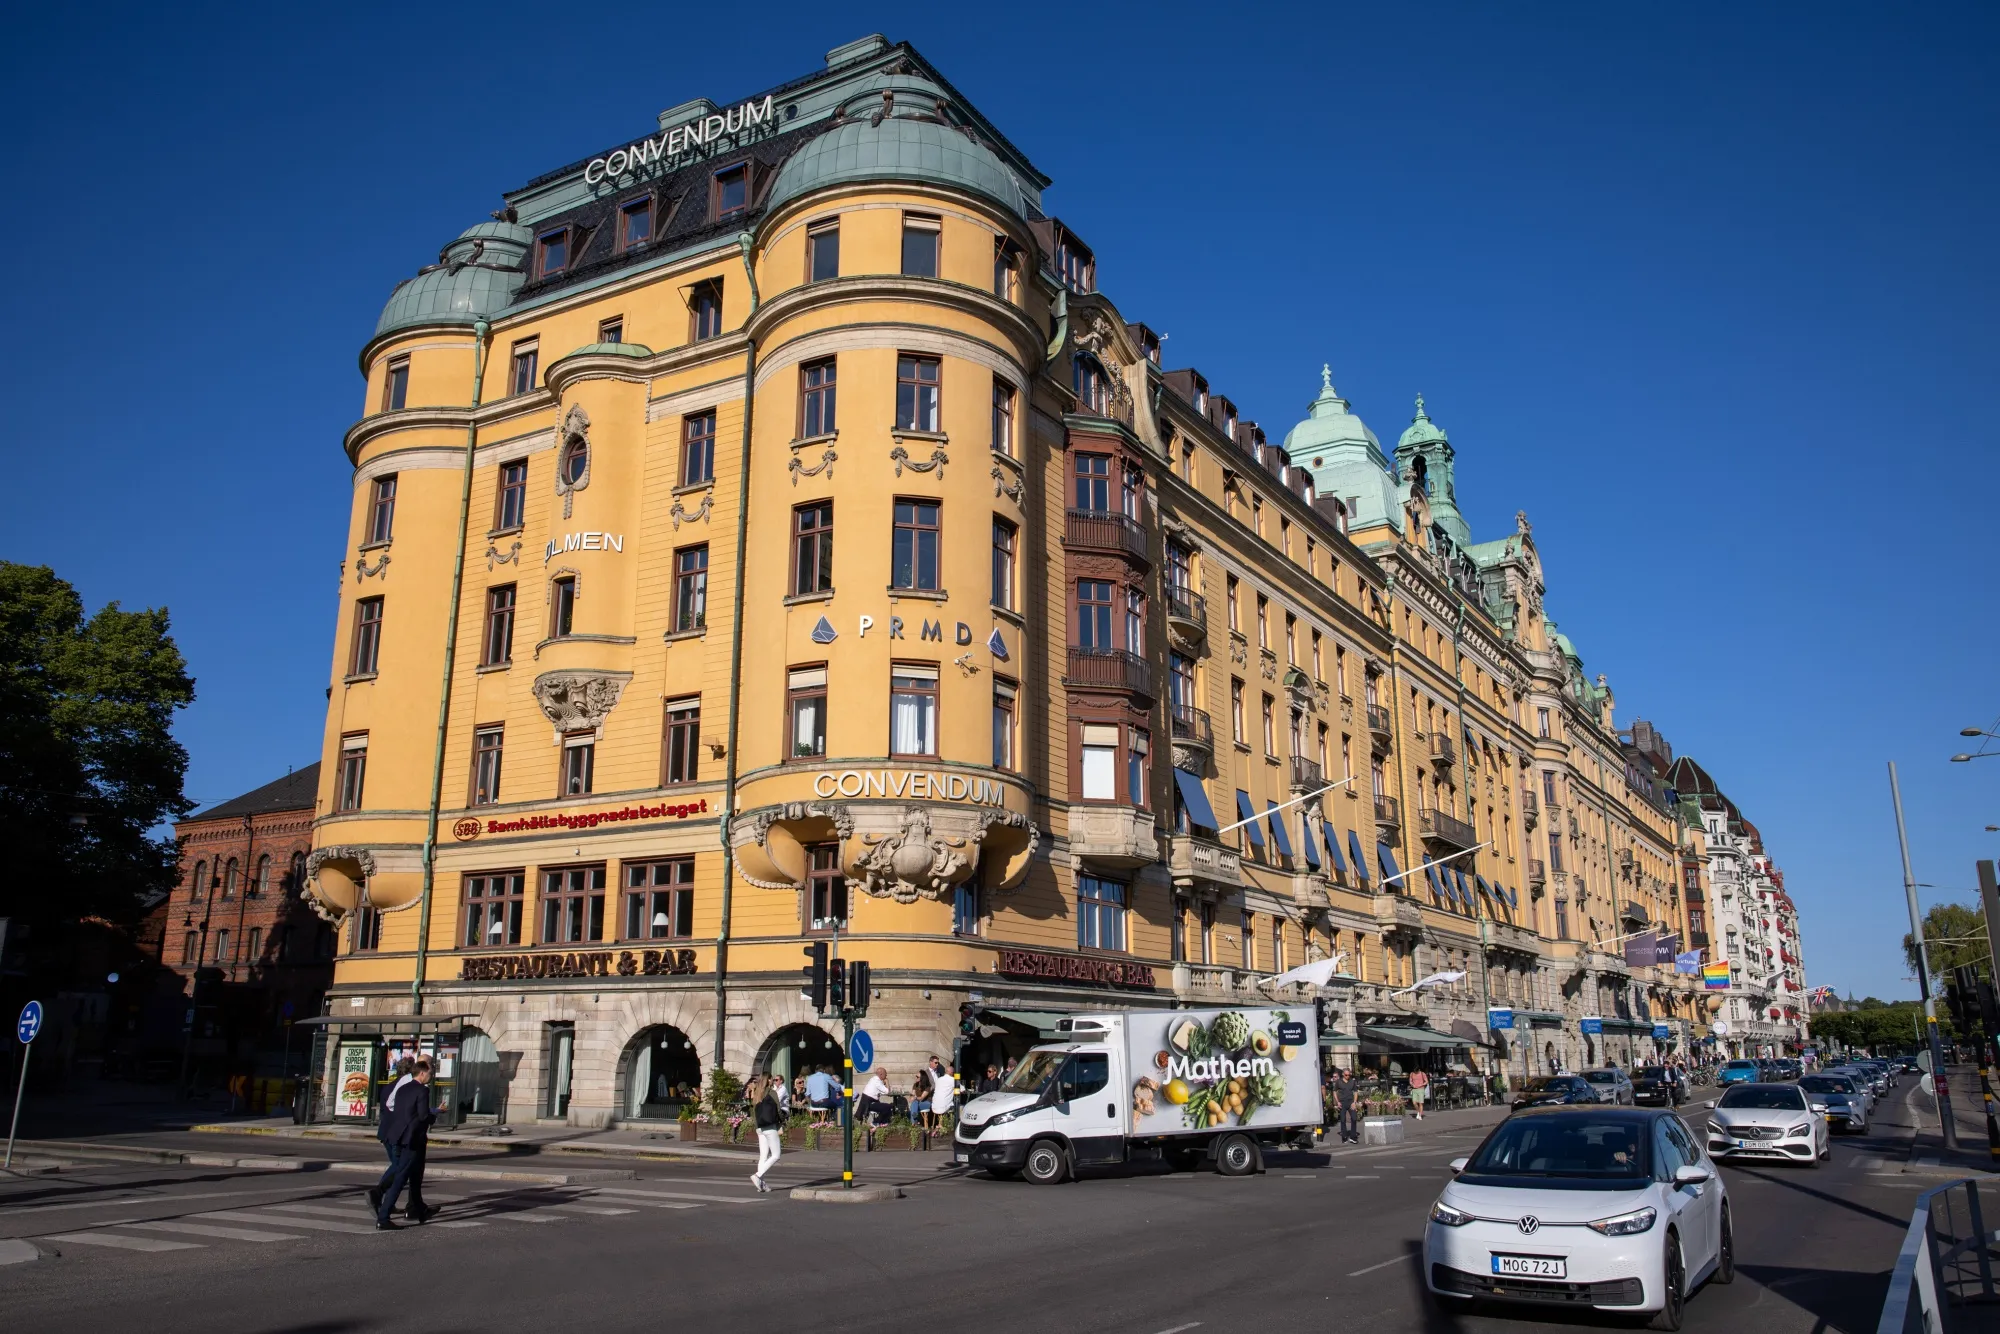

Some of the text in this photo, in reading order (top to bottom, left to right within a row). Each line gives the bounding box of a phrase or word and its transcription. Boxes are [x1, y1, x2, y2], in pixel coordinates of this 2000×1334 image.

[584, 95, 773, 184] CONVENDUM
[814, 770, 1004, 807] CONVENDUM
[456, 799, 708, 837] SBB Samhällsbyggnadsbolaget
[458, 949, 699, 980] RESTAURANT & BAR
[1002, 951, 1156, 987] RESTAURANT & BAR
[344, 1056, 367, 1065] SUPREME
[347, 1048, 366, 1057] CRISPY
[344, 1064, 366, 1073] BUFFALO
[1163, 1054, 1277, 1085] Mathem
[349, 1098, 367, 1116] MAX
[1503, 1259, 1559, 1274] MOG 72J
